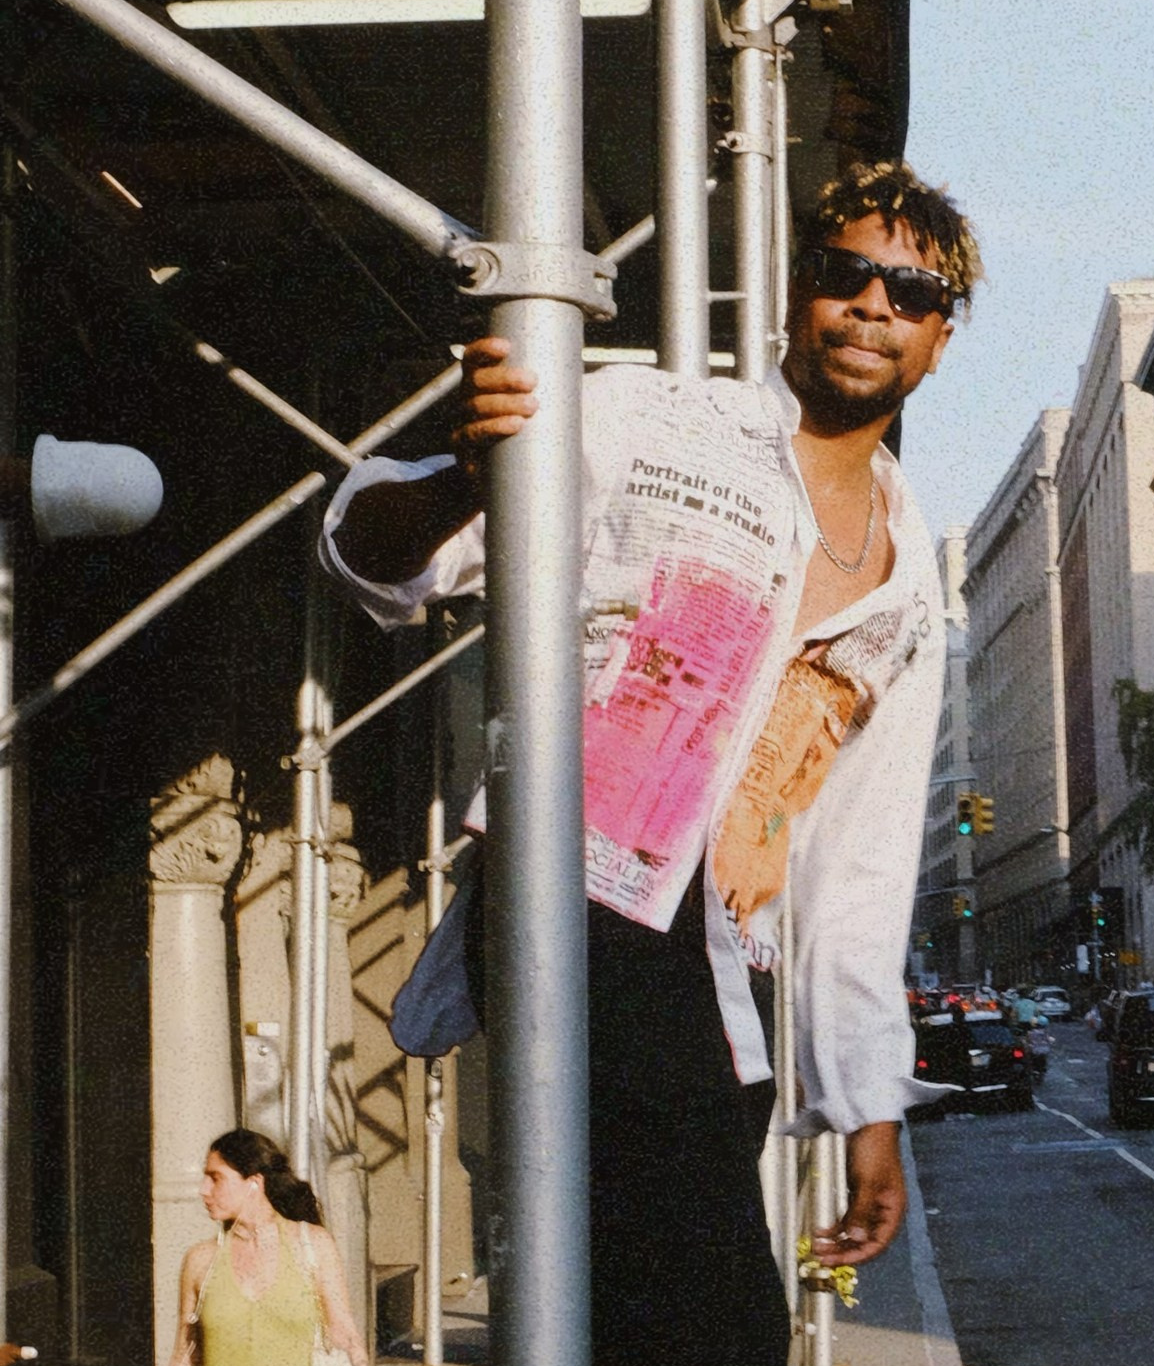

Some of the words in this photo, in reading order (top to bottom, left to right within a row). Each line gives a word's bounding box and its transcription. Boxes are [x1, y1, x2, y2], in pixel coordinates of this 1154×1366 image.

[625, 479, 680, 503] artist
[709, 504, 720, 517] a
[725, 509, 776, 547] studio
[631, 457, 709, 492] Portrait
[713, 483, 731, 501] of
[734, 492, 763, 517] the
